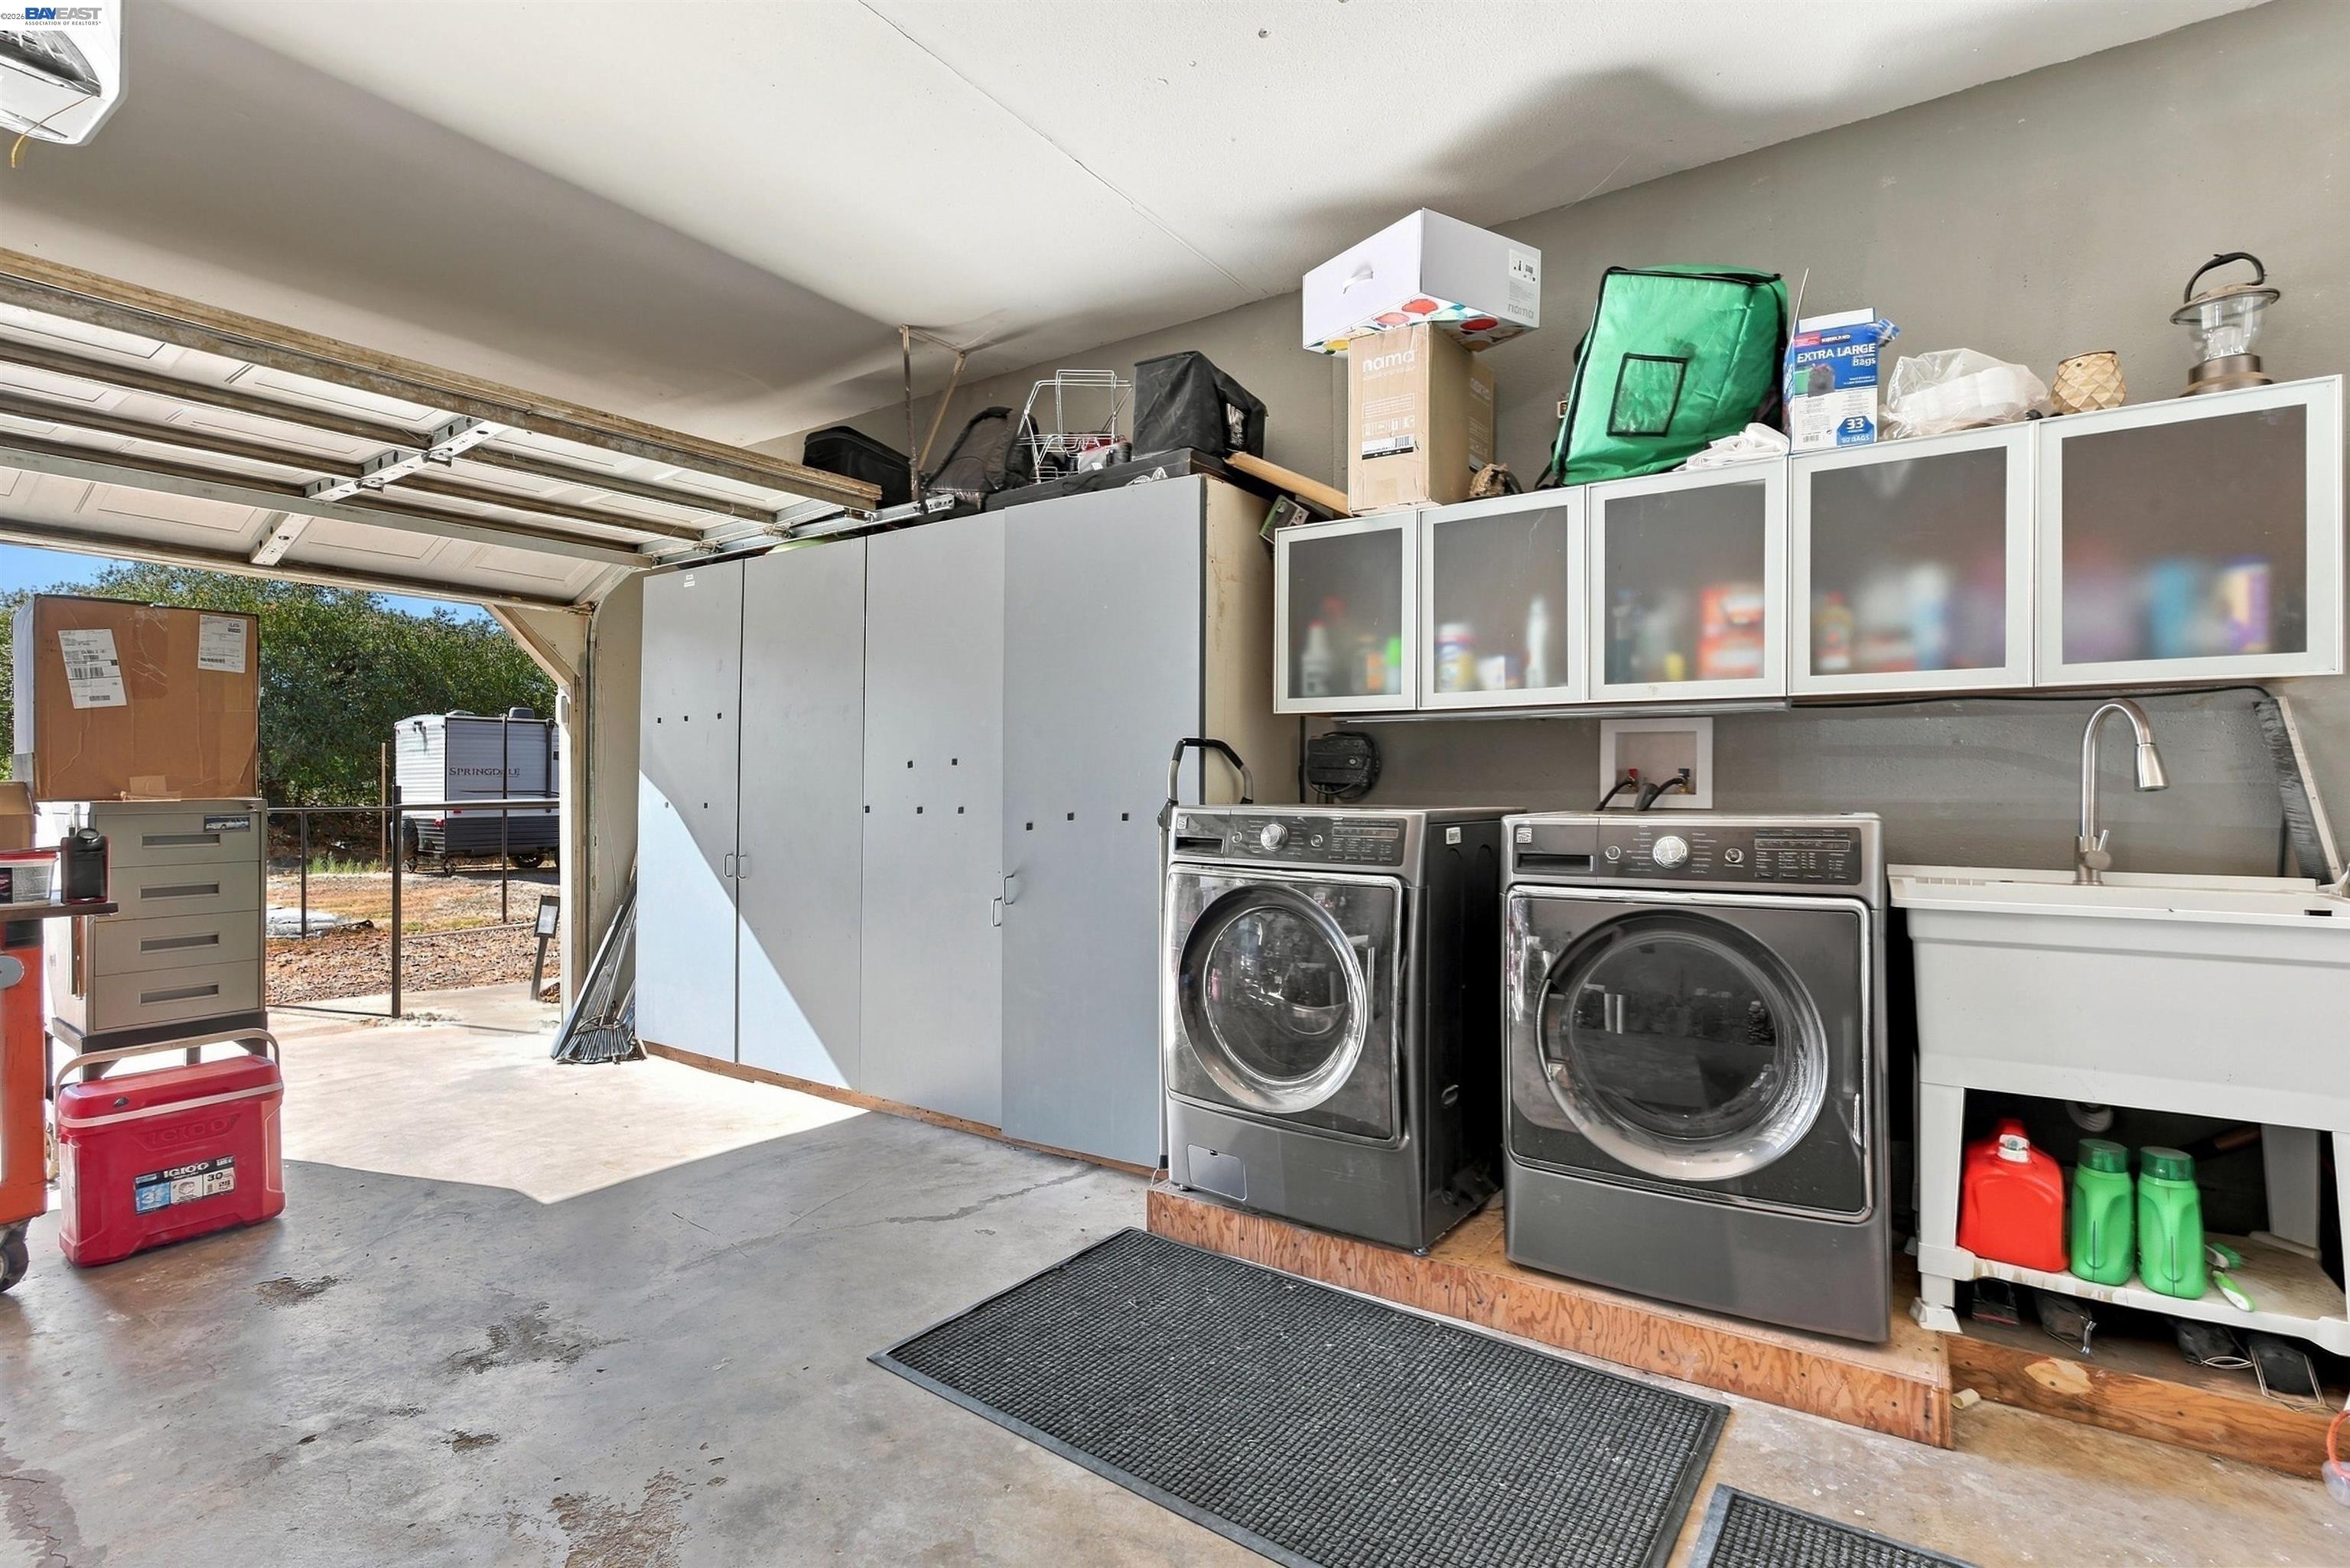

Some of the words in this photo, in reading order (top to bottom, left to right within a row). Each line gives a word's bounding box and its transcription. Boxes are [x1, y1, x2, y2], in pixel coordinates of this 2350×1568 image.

[1508, 303, 1535, 319] nama
[1797, 349, 1835, 363] EXTRA
[1837, 343, 1876, 357] LARGE
[1362, 350, 1415, 372] nama
[1853, 357, 1876, 366] Bags
[1847, 418, 1864, 430] 33
[207, 1172, 223, 1183] 30
